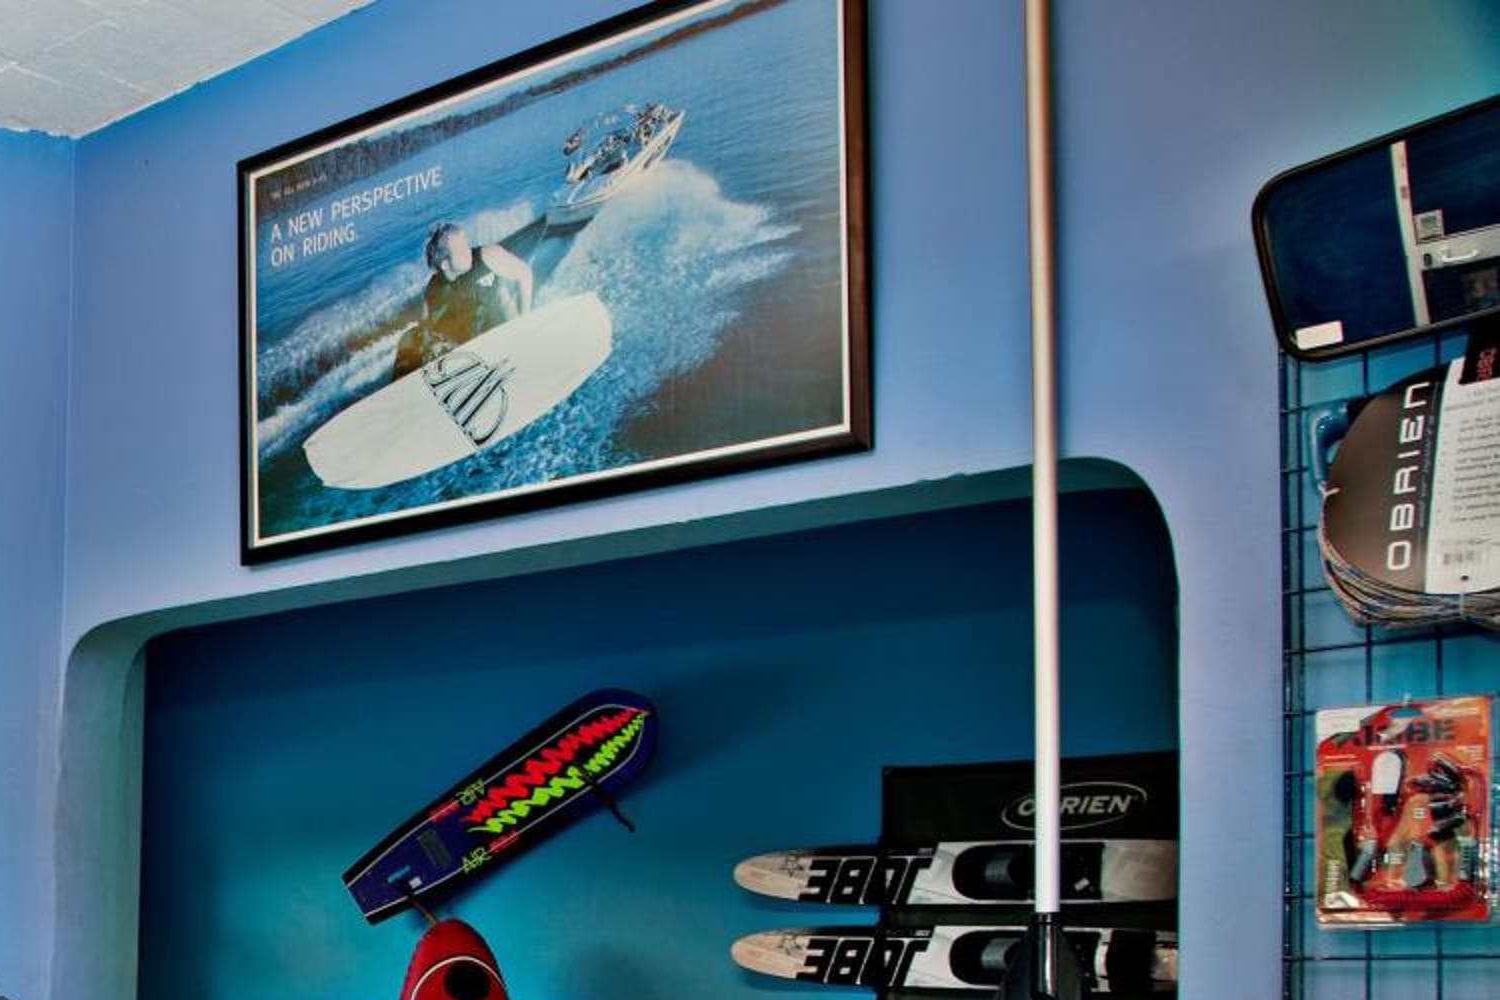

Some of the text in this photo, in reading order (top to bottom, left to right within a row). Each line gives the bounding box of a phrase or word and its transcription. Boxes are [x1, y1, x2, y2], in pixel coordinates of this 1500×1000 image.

[270, 224, 282, 243] A
[288, 208, 323, 237] NEW
[330, 166, 444, 222] PERSPECTIVE
[270, 244, 294, 267] ON
[1387, 381, 1431, 571] OBRIEN
[1017, 795, 1132, 816] ORIEN
